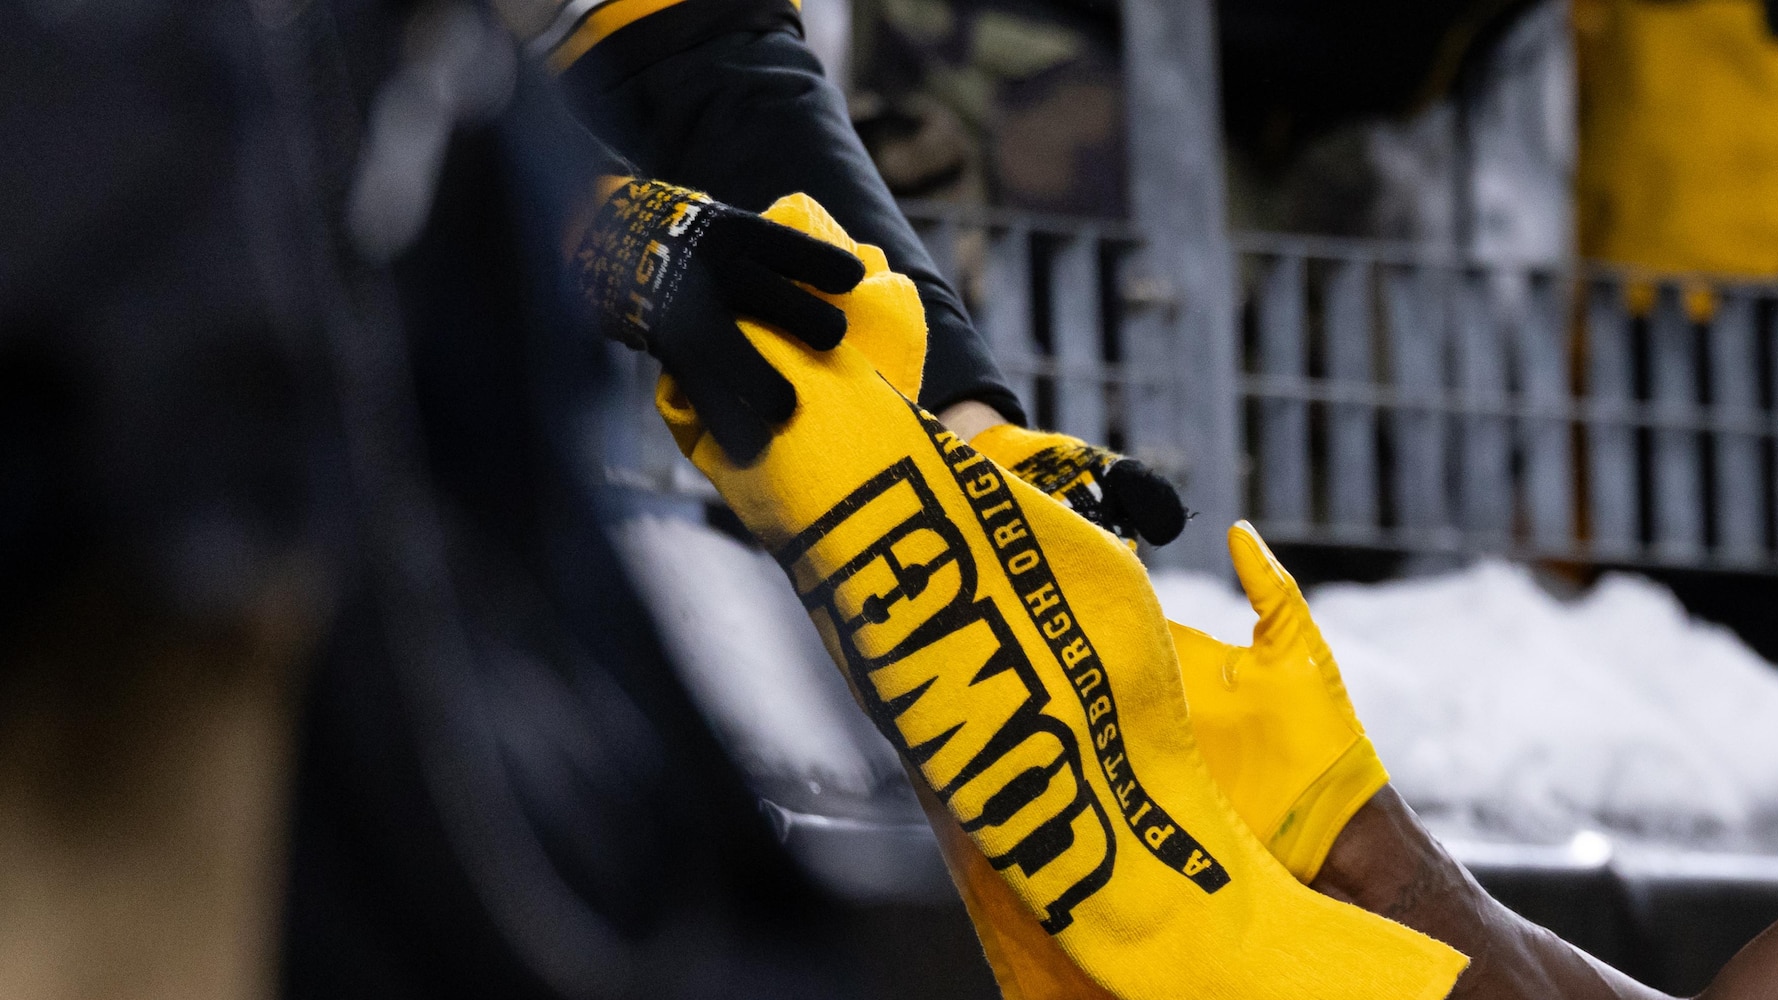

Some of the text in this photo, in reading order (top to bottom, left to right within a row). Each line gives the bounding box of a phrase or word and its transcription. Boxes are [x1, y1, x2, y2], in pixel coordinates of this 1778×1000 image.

[917, 408, 1041, 577] ORIGIN
[1024, 581, 1176, 851] PITTSBURGH
[1182, 849, 1213, 877] A
